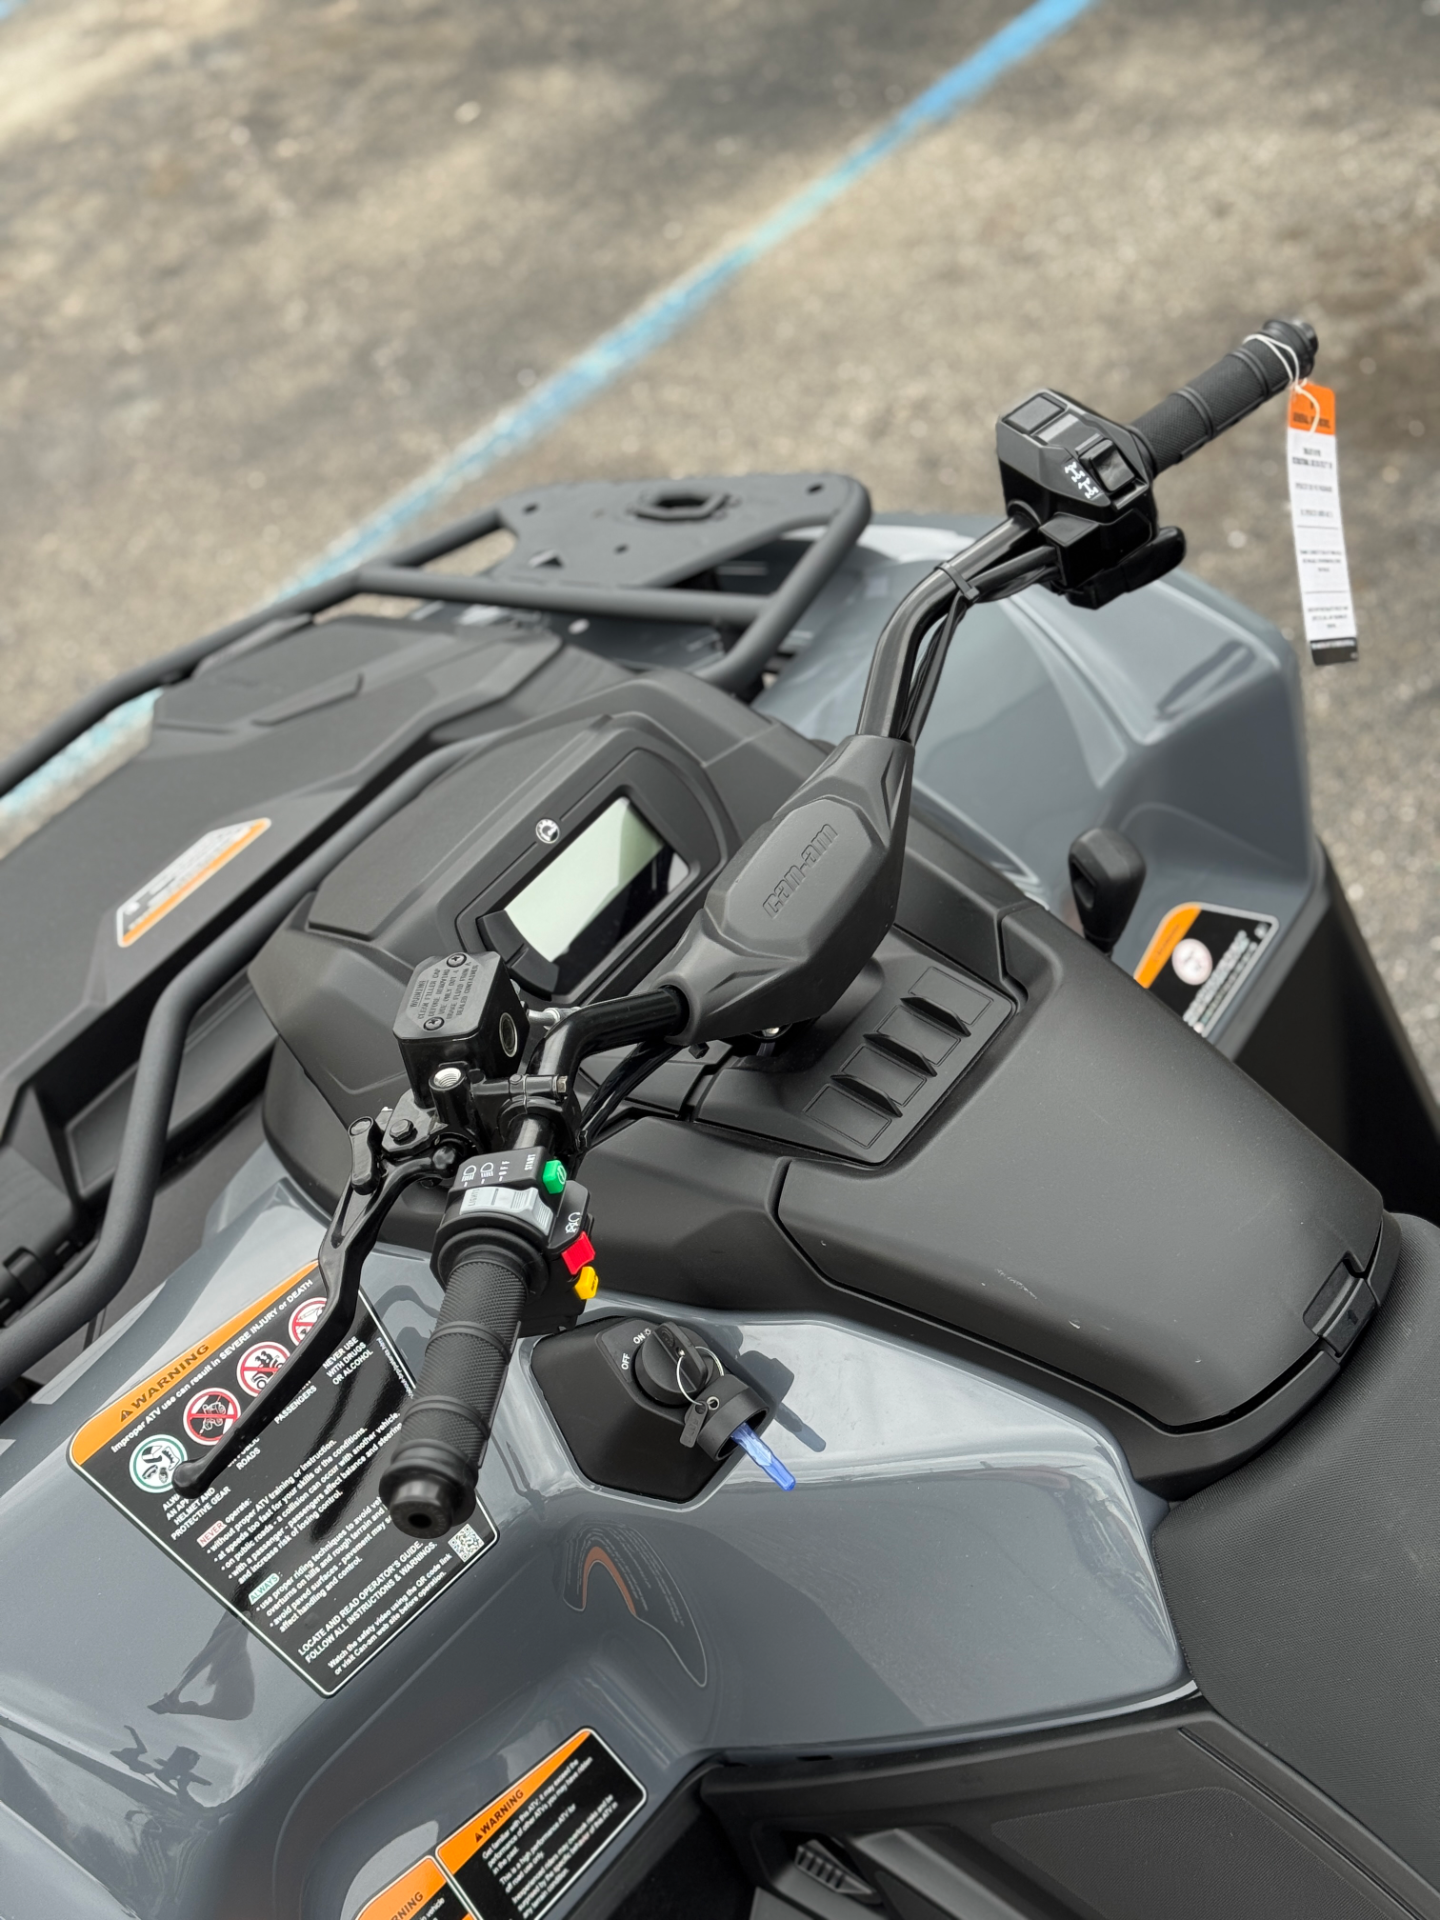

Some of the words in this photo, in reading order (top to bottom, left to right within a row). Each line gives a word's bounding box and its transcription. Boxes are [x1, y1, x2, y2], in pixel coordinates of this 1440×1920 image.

[110, 1421, 146, 1453] Improper
[145, 1406, 161, 1424] ATV
[161, 1396, 176, 1410] use
[175, 1383, 191, 1397] can
[189, 1364, 212, 1385] result
[210, 1358, 221, 1367] in
[219, 1331, 251, 1360] SEVERE
[249, 1307, 278, 1334] INJURY
[278, 1301, 287, 1310] or
[286, 1279, 313, 1303] DEATH
[322, 1347, 345, 1369] NEVER
[343, 1336, 358, 1350] USE
[326, 1360, 345, 1377] WITH
[342, 1341, 366, 1363] DRUGS
[332, 1373, 344, 1385] OR
[342, 1349, 374, 1377] ALCOHOL
[620, 1352, 631, 1371] OFF
[633, 1331, 646, 1345] ON
[130, 1344, 211, 1410] WARNING
[273, 1384, 317, 1424] PASSENGERS
[217, 1550, 226, 1560] at
[224, 1530, 249, 1554] speeds
[247, 1520, 260, 1533] too
[258, 1508, 273, 1523] fast
[270, 1499, 283, 1511] for
[281, 1486, 298, 1504] your
[296, 1472, 315, 1489] skills
[313, 1465, 322, 1474] or
[320, 1455, 333, 1467] the
[332, 1427, 367, 1458] conditions.
[225, 1557, 235, 1568] on
[233, 1540, 256, 1561] public
[253, 1523, 274, 1543] roads
[281, 1491, 309, 1518] collision
[308, 1481, 321, 1494] can
[320, 1464, 339, 1483] occur
[337, 1452, 353, 1467] with
[351, 1431, 376, 1455] another
[375, 1412, 401, 1433] vehicle.
[235, 1447, 261, 1470] ROADS
[170, 1502, 212, 1540] PROTECTIVE
[210, 1486, 231, 1505] GEAR
[173, 1499, 201, 1525] HELMET
[200, 1487, 215, 1503] AND
[209, 1527, 236, 1551] without
[234, 1508, 256, 1532] proper
[255, 1495, 269, 1512] ATV
[267, 1476, 295, 1500] training
[293, 1468, 301, 1478] or
[299, 1439, 337, 1471] instruction.
[231, 1562, 247, 1576] with
[251, 1527, 285, 1561] passenger
[287, 1492, 324, 1528] passengers
[323, 1475, 342, 1495] affect
[339, 1455, 366, 1479] balance
[365, 1443, 379, 1458] and
[199, 1522, 224, 1544] NEVER
[237, 1569, 252, 1584] and
[249, 1546, 279, 1573] increase
[277, 1534, 292, 1549] risk
[290, 1526, 299, 1537] of
[296, 1510, 320, 1531] losing
[317, 1489, 343, 1513] control.
[259, 1596, 273, 1609] use
[271, 1576, 294, 1600] proper
[293, 1559, 314, 1579] riding
[311, 1529, 347, 1562] techniques
[345, 1522, 354, 1531] to
[353, 1505, 372, 1525] avoid
[266, 1587, 297, 1616] overturns
[296, 1578, 307, 1589] on
[304, 1566, 320, 1581] hills
[319, 1553, 333, 1569] and
[331, 1537, 352, 1557] rough
[349, 1519, 373, 1540] terrain
[371, 1506, 385, 1521] and
[272, 1605, 292, 1625] avoid
[290, 1587, 312, 1610] paved
[310, 1564, 338, 1591] surfaces
[340, 1533, 373, 1565] pavement
[370, 1521, 386, 1537] may
[279, 1612, 299, 1632] affect
[295, 1588, 327, 1616] handling
[324, 1575, 339, 1591] and
[337, 1555, 363, 1579] control.
[297, 1627, 327, 1656] LOCATE
[325, 1614, 341, 1632] AND
[339, 1597, 360, 1618] READ
[399, 1540, 423, 1562] GUIDE.
[304, 1633, 335, 1663] FOLLOW
[333, 1623, 349, 1638] ALL
[346, 1578, 395, 1625] INSTRUCTIONS
[393, 1573, 402, 1581] &
[398, 1541, 437, 1576] WARNINGS.
[479, 1789, 524, 1836] WARNING
